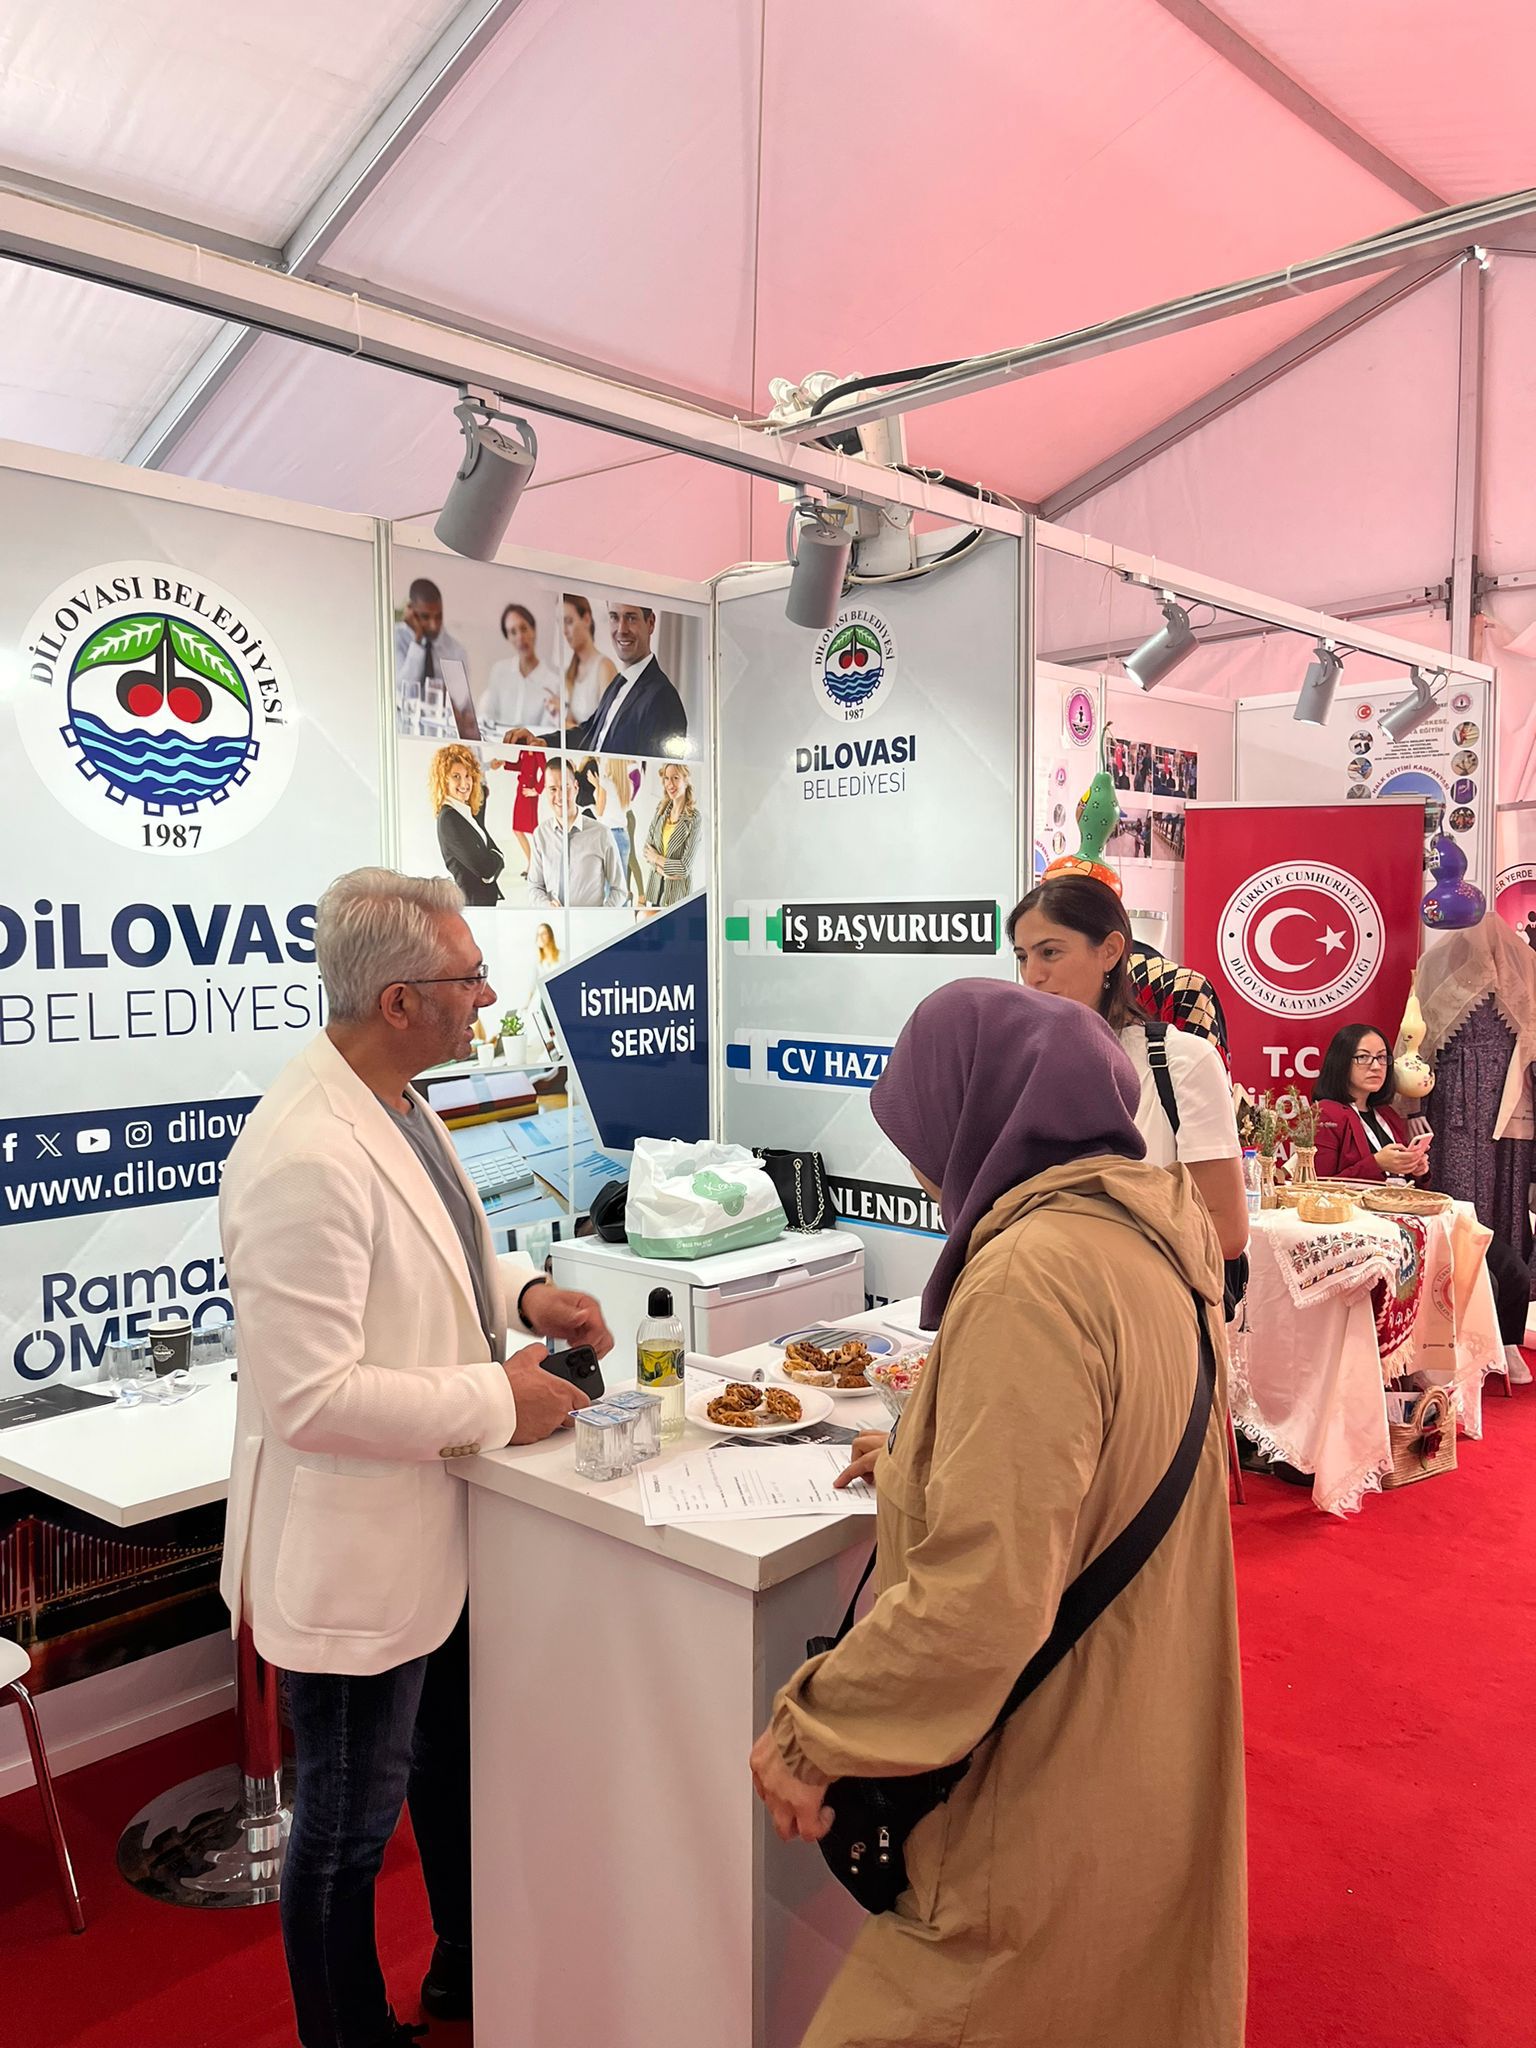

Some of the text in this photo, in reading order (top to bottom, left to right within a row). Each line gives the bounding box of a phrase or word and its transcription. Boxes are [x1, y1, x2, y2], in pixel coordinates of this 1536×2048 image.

[29, 577, 288, 726] DİLOVASI BELEDİYESİ
[850, 610, 896, 661] BELEDİYESİ
[844, 708, 865, 721] 1987
[803, 767, 906, 801] BELEDİYESİ
[1386, 763, 1412, 778] EĞİTİMİ
[1413, 764, 1451, 791] KAMPANYASI
[141, 823, 203, 849] 1987
[1234, 871, 1371, 916] TÜRKİYE CUMHURİYETİ
[1505, 869, 1533, 883] YERDE
[784, 907, 994, 950] İŞ BAŞVURUSU
[580, 979, 695, 1018] İSTİHDAM
[1230, 957, 1372, 1010] DİLOVASI KAYMAKAMLIĞI
[0, 974, 324, 1046] BELEDİYESİ
[610, 1019, 695, 1058] SERVİSİ
[781, 1047, 817, 1076] CV
[168, 1109, 253, 1144] dilov
